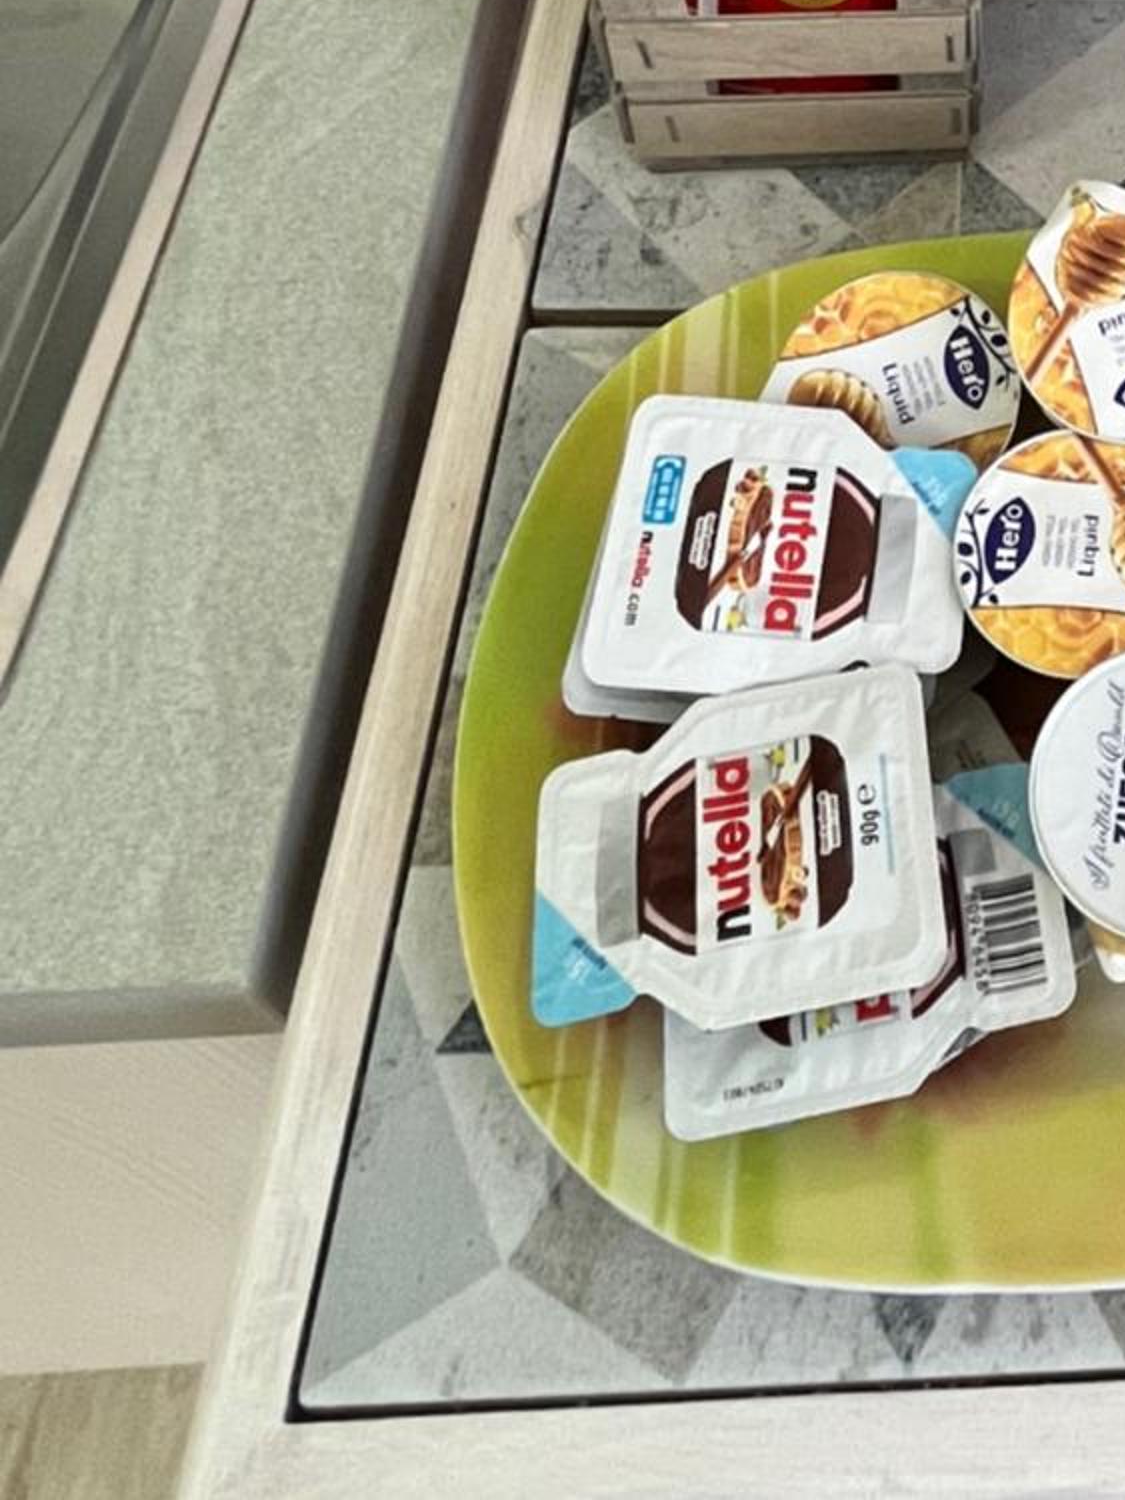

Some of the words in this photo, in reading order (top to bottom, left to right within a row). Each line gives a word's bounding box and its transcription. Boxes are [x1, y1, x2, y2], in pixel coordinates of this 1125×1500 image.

[882, 362, 916, 425] Liquid
[950, 335, 986, 401] Hero
[763, 467, 818, 632] nutella
[994, 503, 1025, 572] Hero
[1077, 513, 1101, 578] Liquid
[702, 754, 752, 942] nutella
[859, 808, 881, 847] 90g
